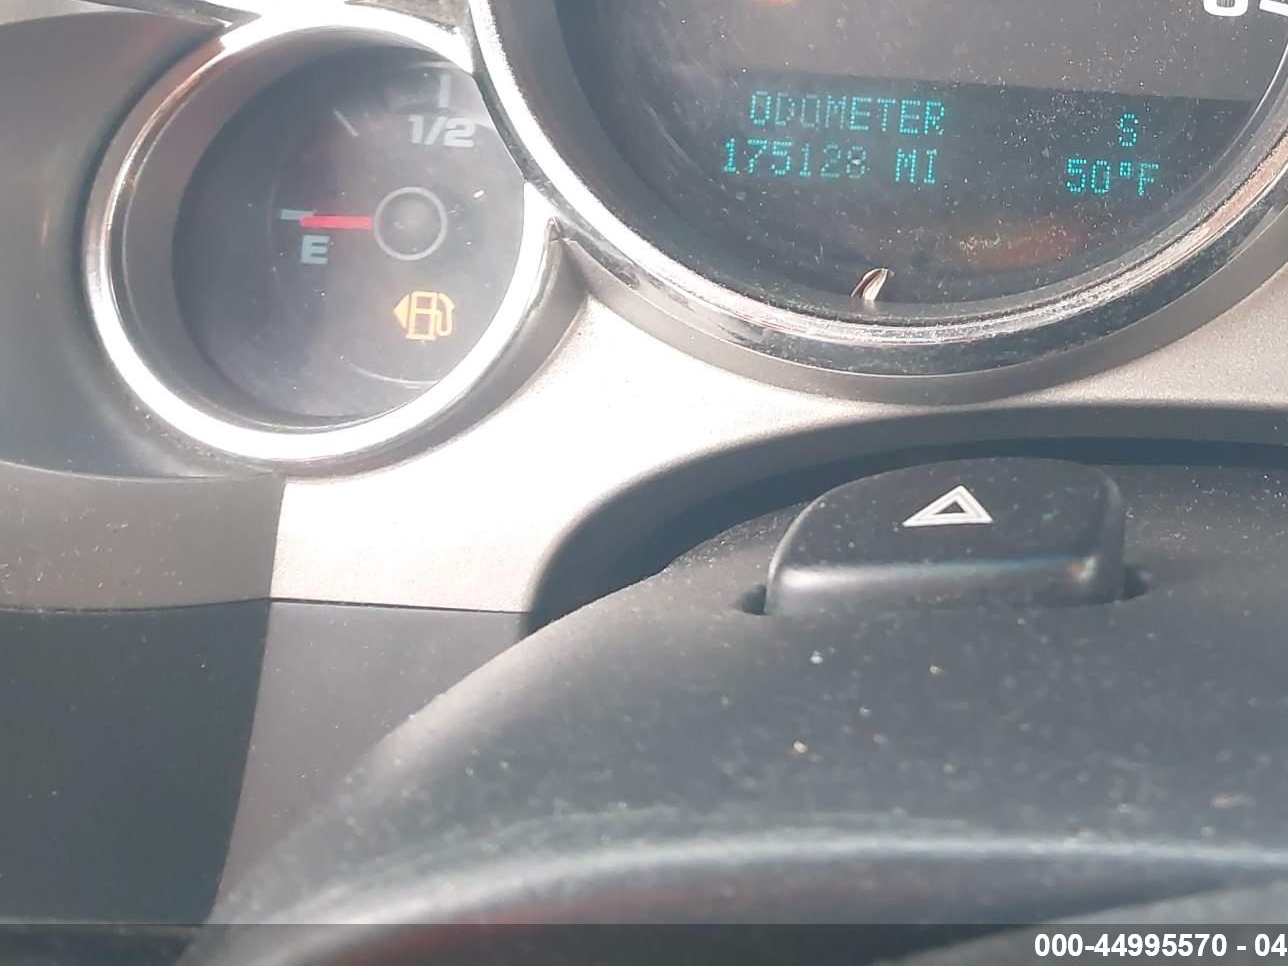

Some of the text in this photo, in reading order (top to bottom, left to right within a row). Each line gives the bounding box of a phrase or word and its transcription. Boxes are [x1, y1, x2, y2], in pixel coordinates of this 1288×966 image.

[749, 90, 946, 135] ODOMETER
[407, 114, 476, 148] 1/2
[1119, 113, 1139, 147] S
[894, 147, 938, 184] MI
[301, 235, 331, 264] E
